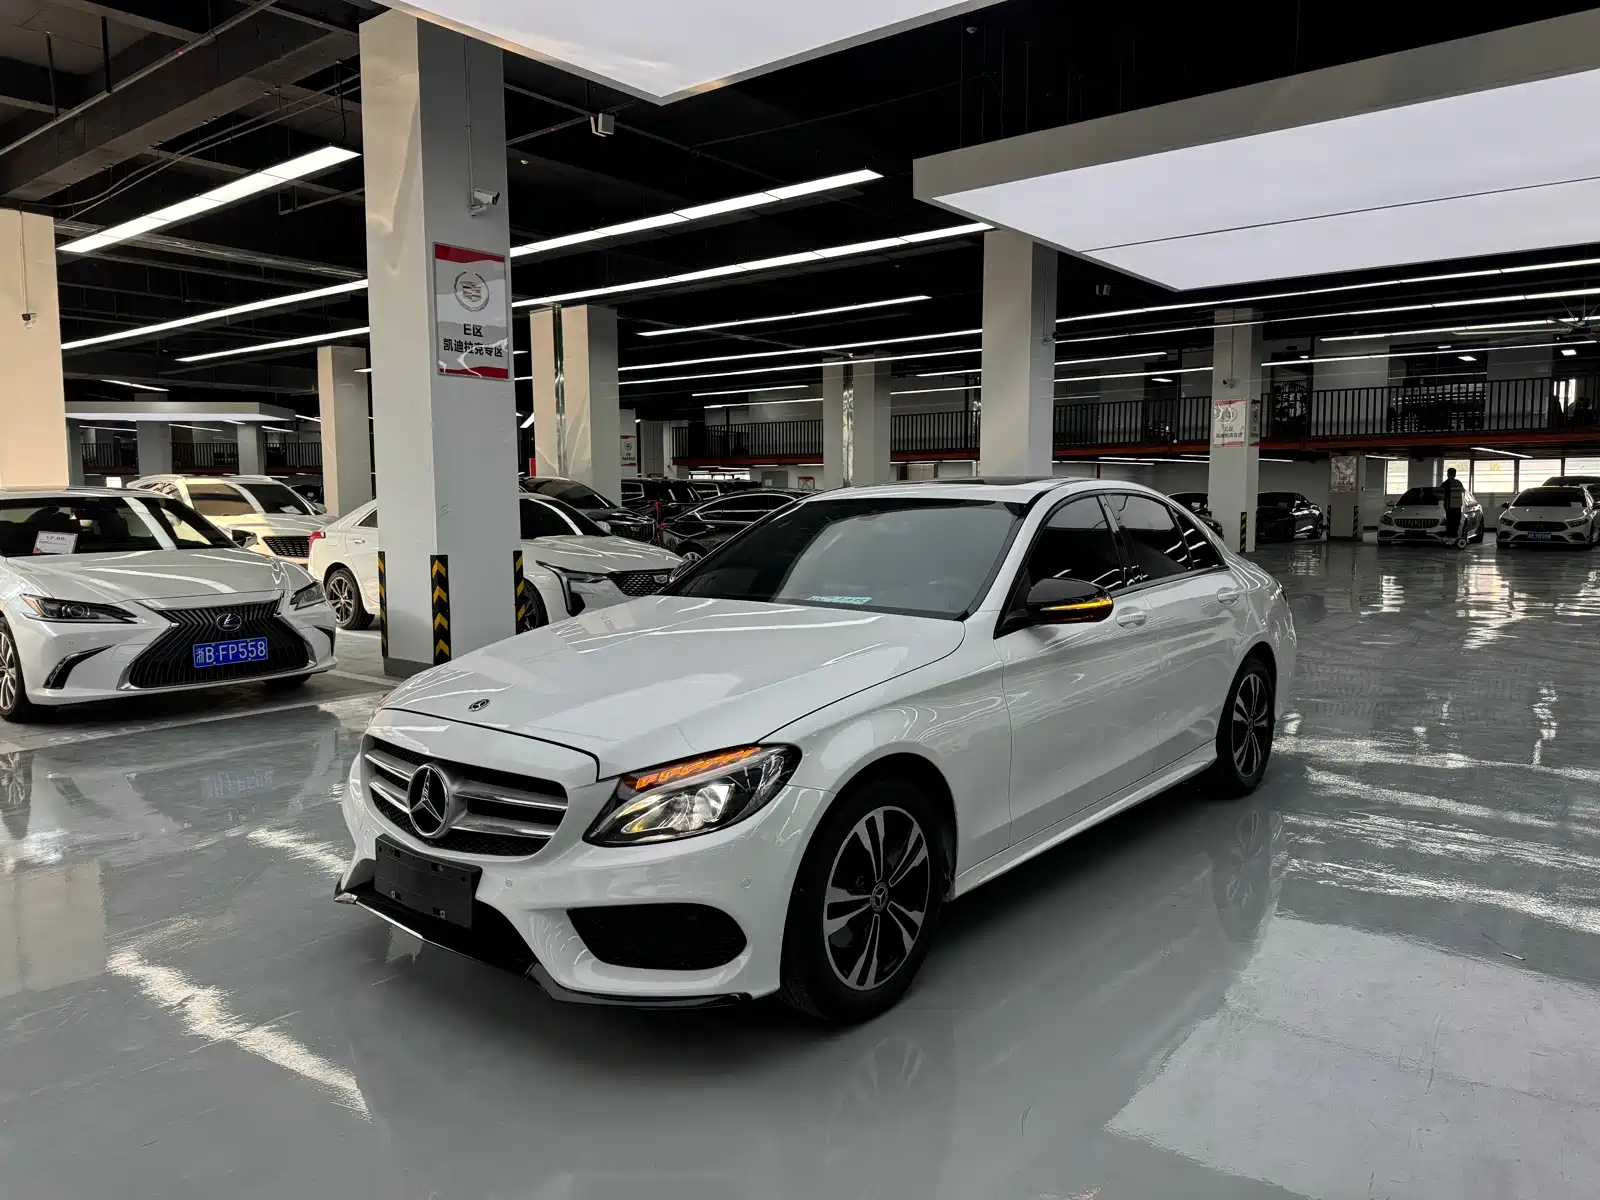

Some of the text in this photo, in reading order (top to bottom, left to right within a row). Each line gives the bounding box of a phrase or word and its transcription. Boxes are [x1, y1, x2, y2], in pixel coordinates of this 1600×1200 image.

[463, 323, 483, 337] E区
[443, 338, 503, 357] 凯迪拉克专区
